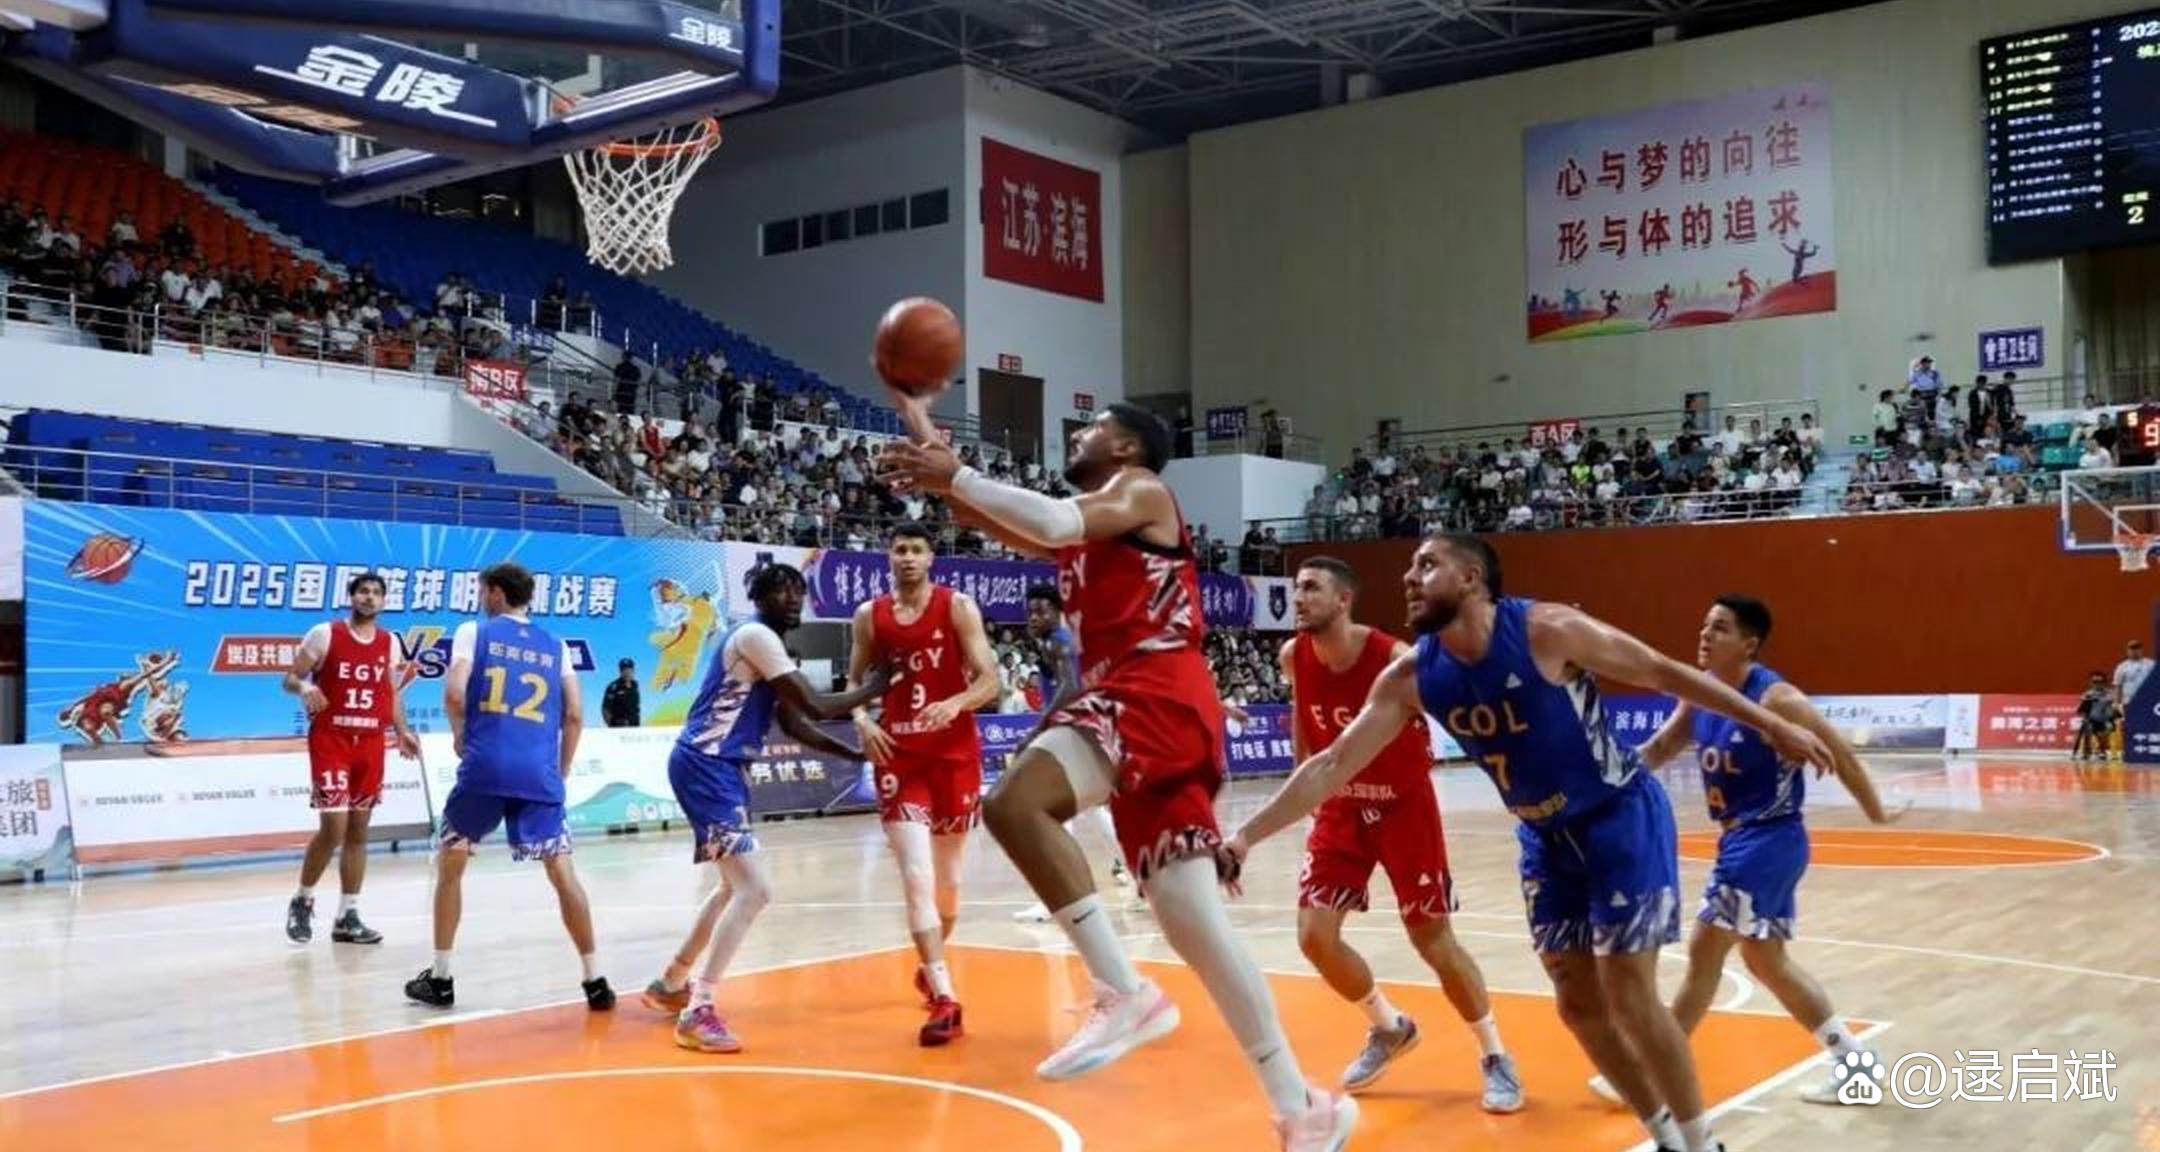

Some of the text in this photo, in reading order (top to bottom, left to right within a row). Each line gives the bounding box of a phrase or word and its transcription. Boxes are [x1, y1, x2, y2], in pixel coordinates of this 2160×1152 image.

[669, 17, 743, 54] 金陵
[254, 45, 497, 128] 金陵
[1557, 121, 1801, 198] 心与梦的向往
[1558, 191, 1802, 264] 形与体的追求
[2127, 205, 2145, 225] 2
[338, 661, 385, 682] EGY
[893, 647, 945, 672] GY
[344, 687, 374, 709] 15
[480, 665, 549, 724] 12
[911, 683, 926, 709] 9
[1447, 701, 1529, 737] COL
[322, 770, 348, 791] 15
[880, 773, 899, 799] 9
[1483, 754, 1511, 791] 7
[0, 779, 34, 807] 旅
